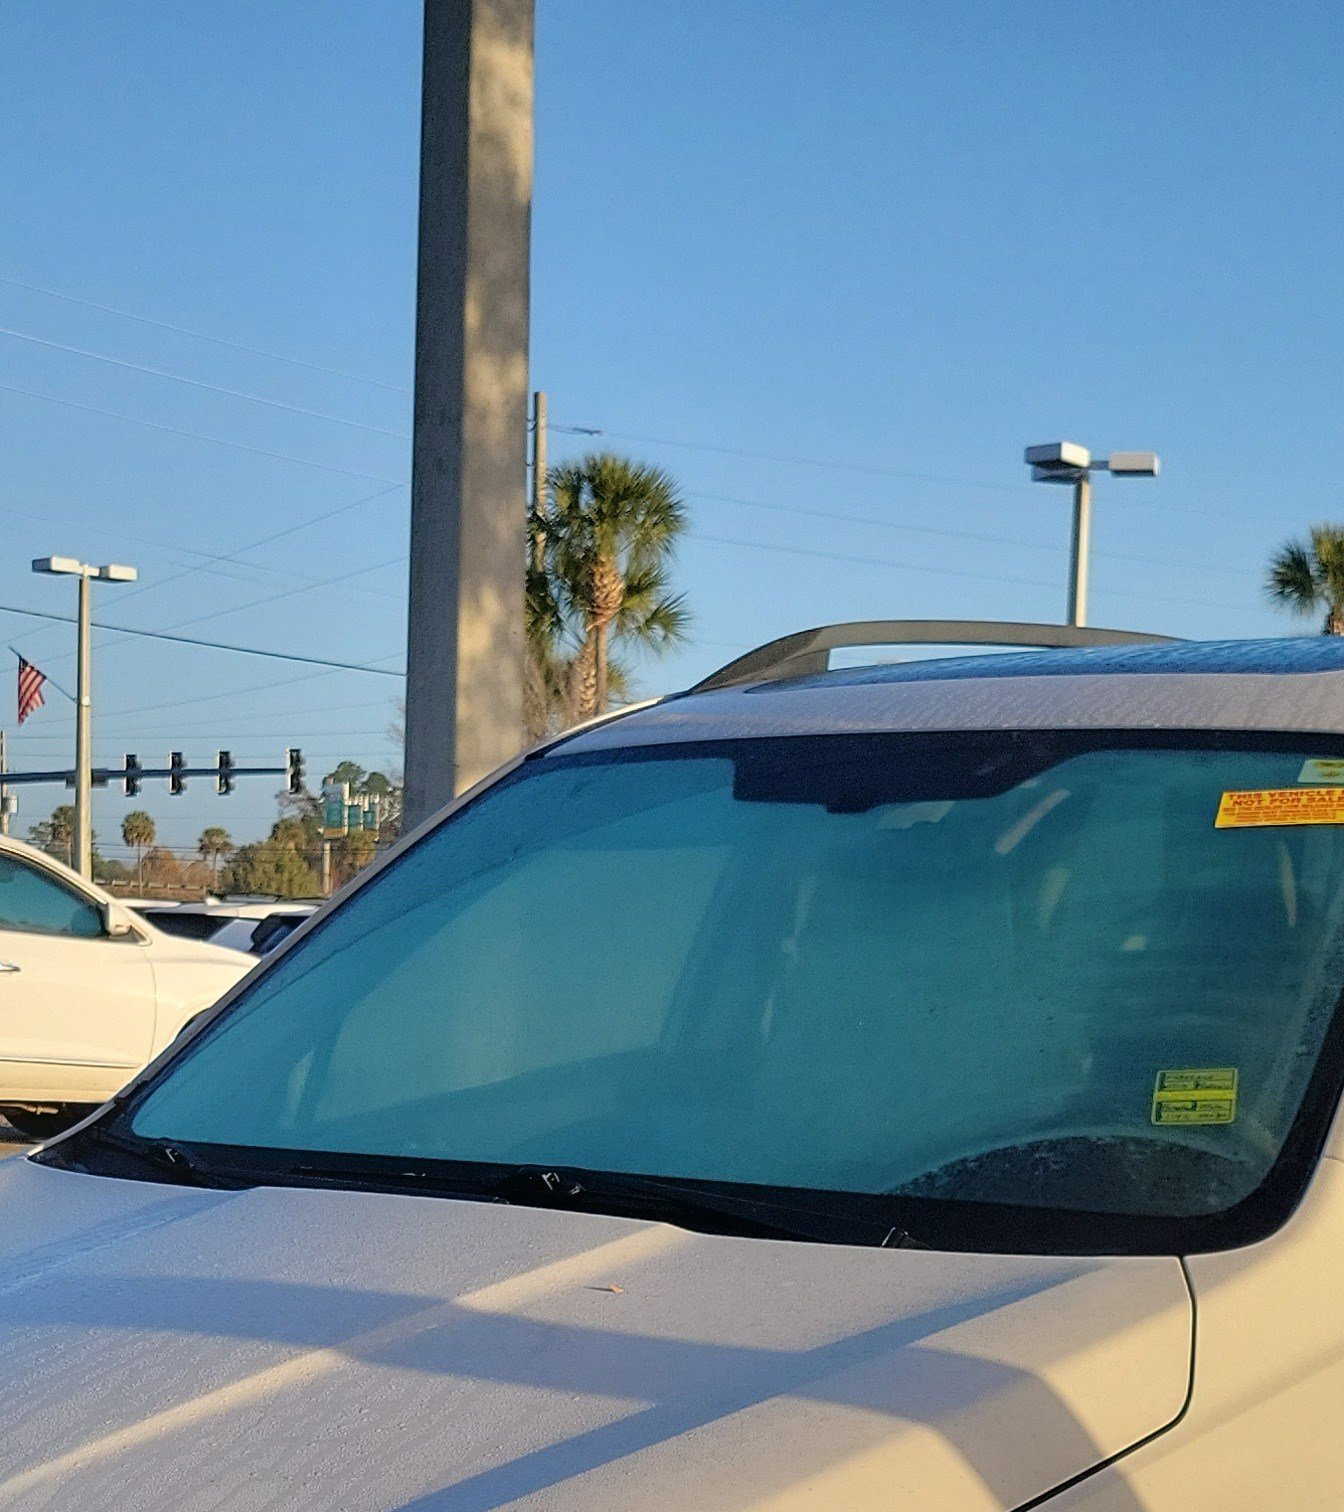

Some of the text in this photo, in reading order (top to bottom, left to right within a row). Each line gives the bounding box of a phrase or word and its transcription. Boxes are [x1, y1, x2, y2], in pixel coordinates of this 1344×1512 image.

[1228, 792, 1263, 801] THIS
[1267, 789, 1335, 799] VEHICLE
[1231, 798, 1264, 807] NOT
[1269, 797, 1301, 806] FOR
